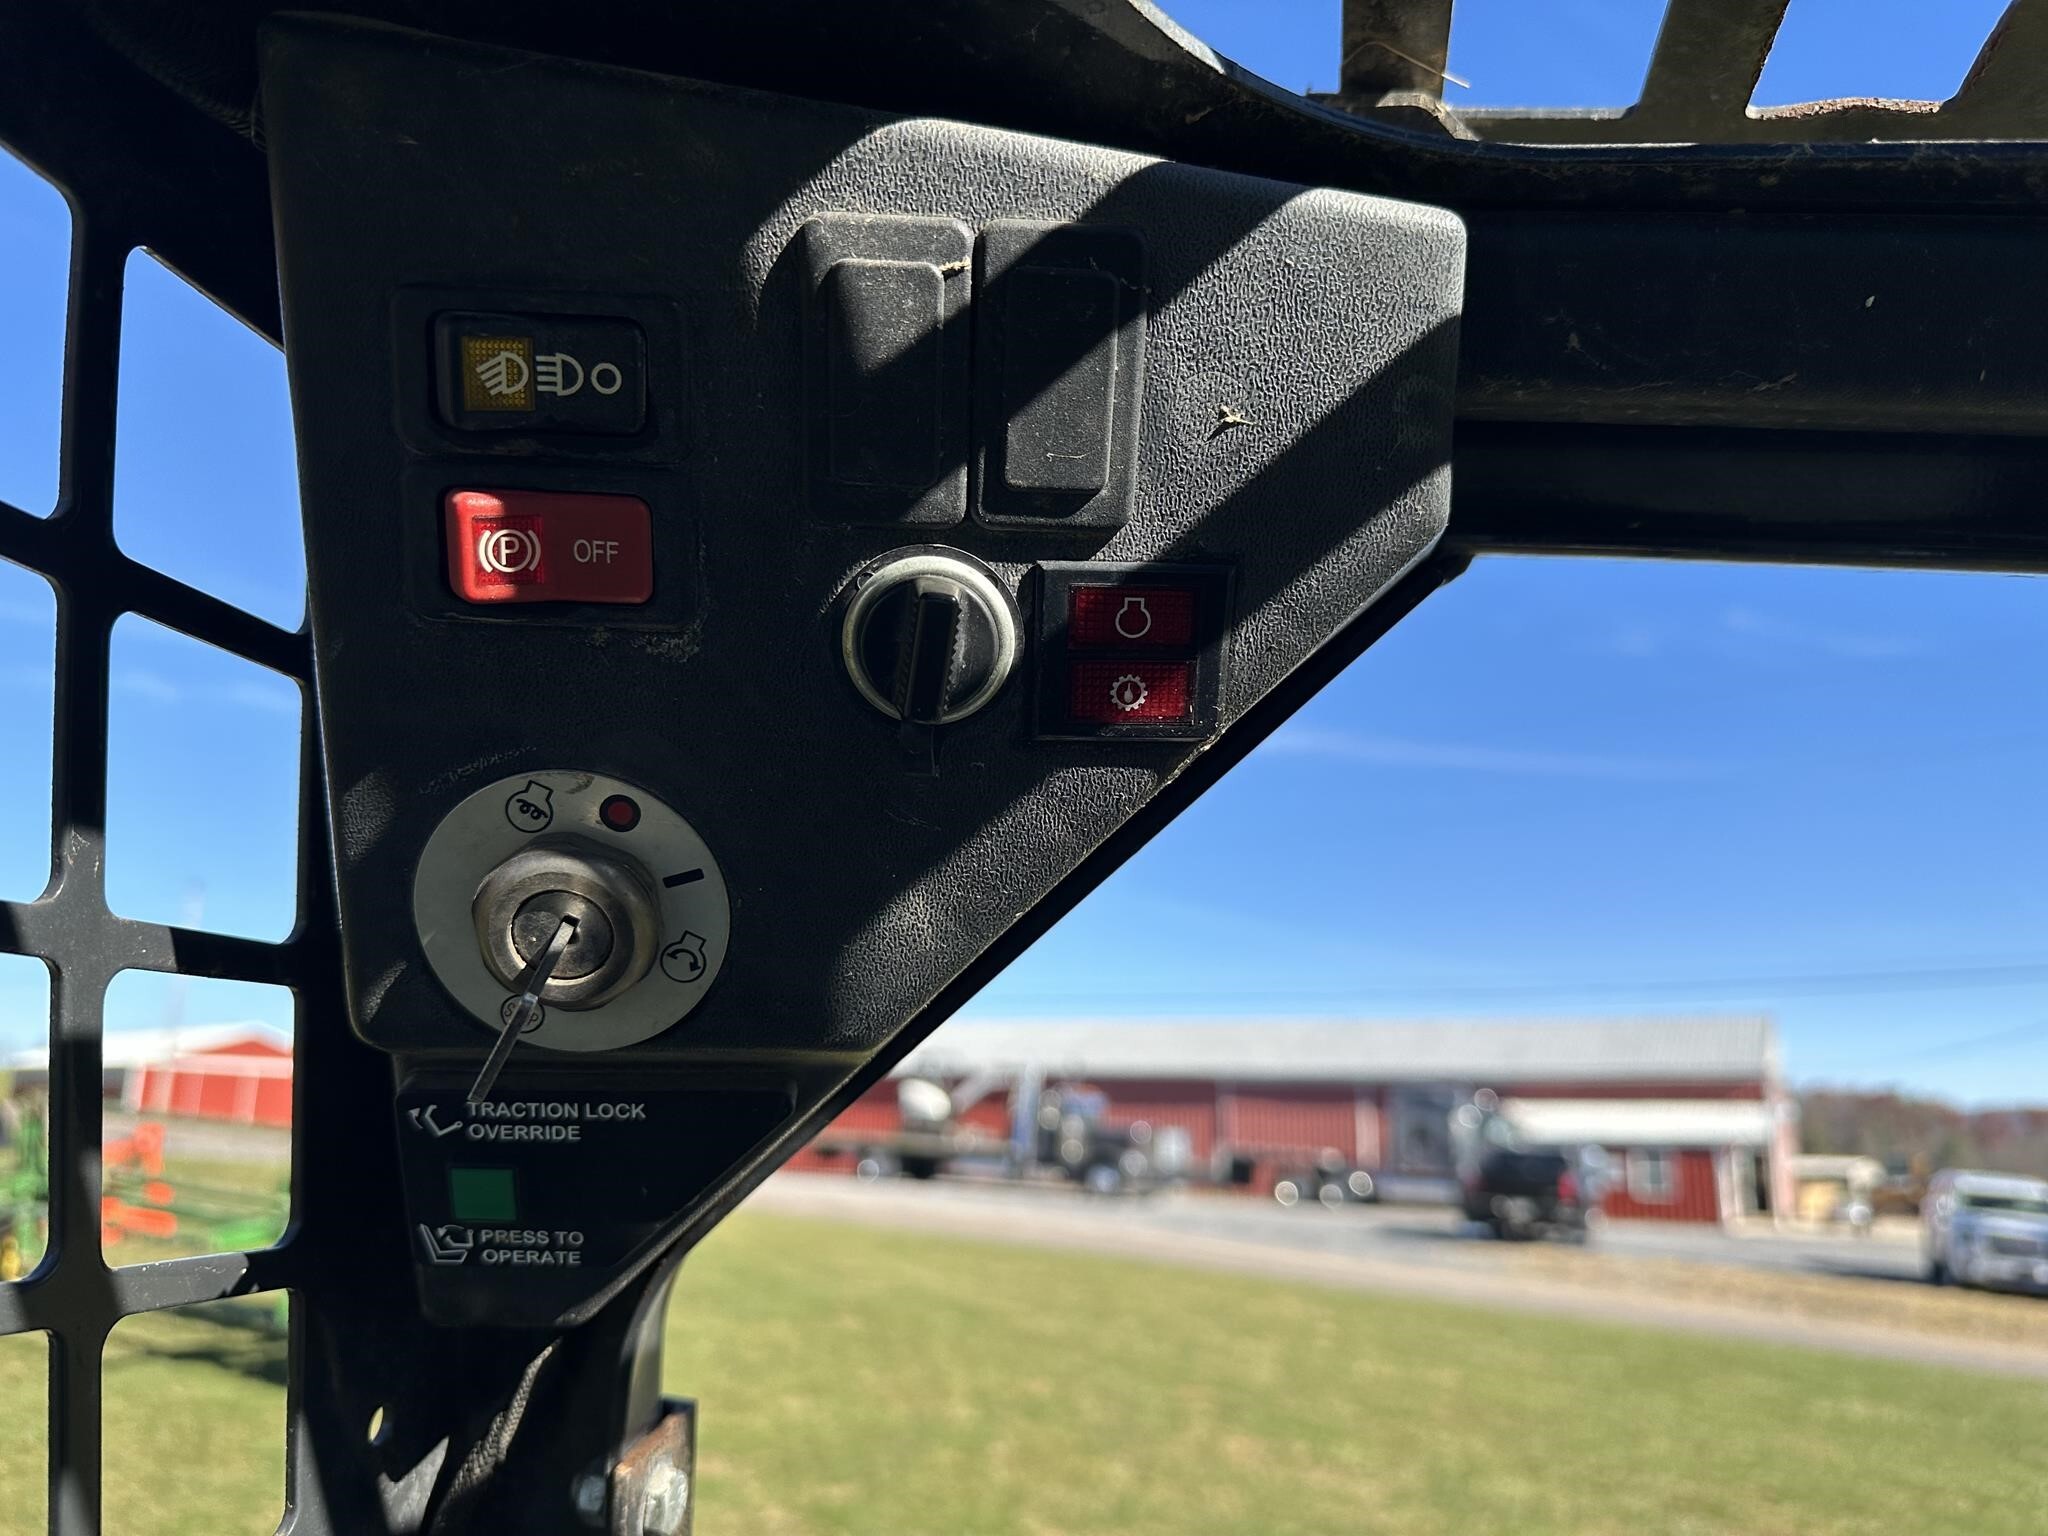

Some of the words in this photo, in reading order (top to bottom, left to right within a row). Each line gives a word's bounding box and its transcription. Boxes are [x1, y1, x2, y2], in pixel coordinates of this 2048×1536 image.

[501, 536, 520, 566] P
[573, 539, 619, 564] OFF
[503, 1002, 539, 1025] SP
[467, 1101, 579, 1118] TRACTION
[585, 1102, 647, 1119] LOCK
[469, 1123, 582, 1140] OVERRIDE
[480, 1229, 549, 1245] PRESS
[554, 1230, 584, 1246] TO
[482, 1249, 582, 1265] OPERATE
